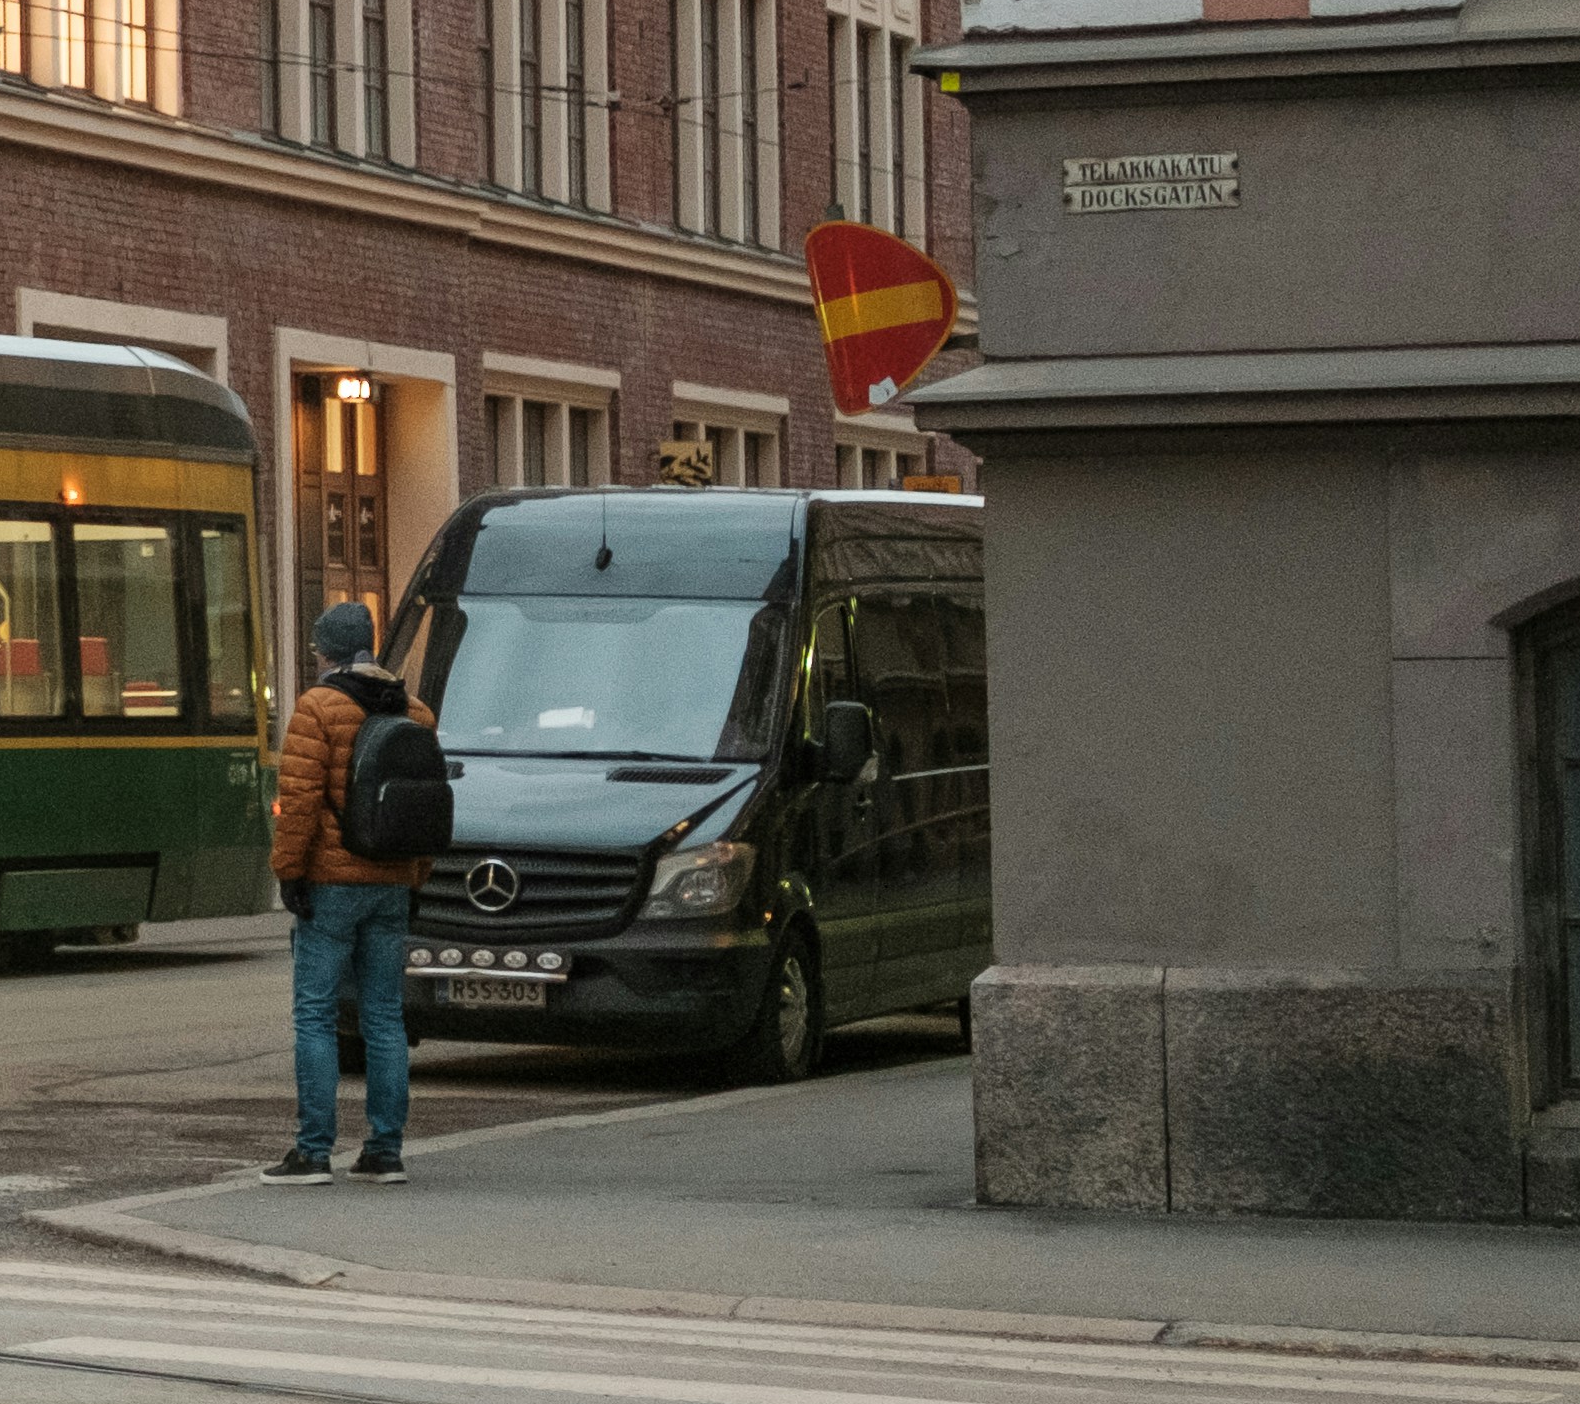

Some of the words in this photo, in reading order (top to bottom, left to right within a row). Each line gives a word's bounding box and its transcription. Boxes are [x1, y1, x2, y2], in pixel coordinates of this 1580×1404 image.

[1078, 156, 1222, 182] TELAKKAKATU
[1080, 183, 1224, 209] DOCKSGATAN
[452, 978, 541, 1002] RSS-303
